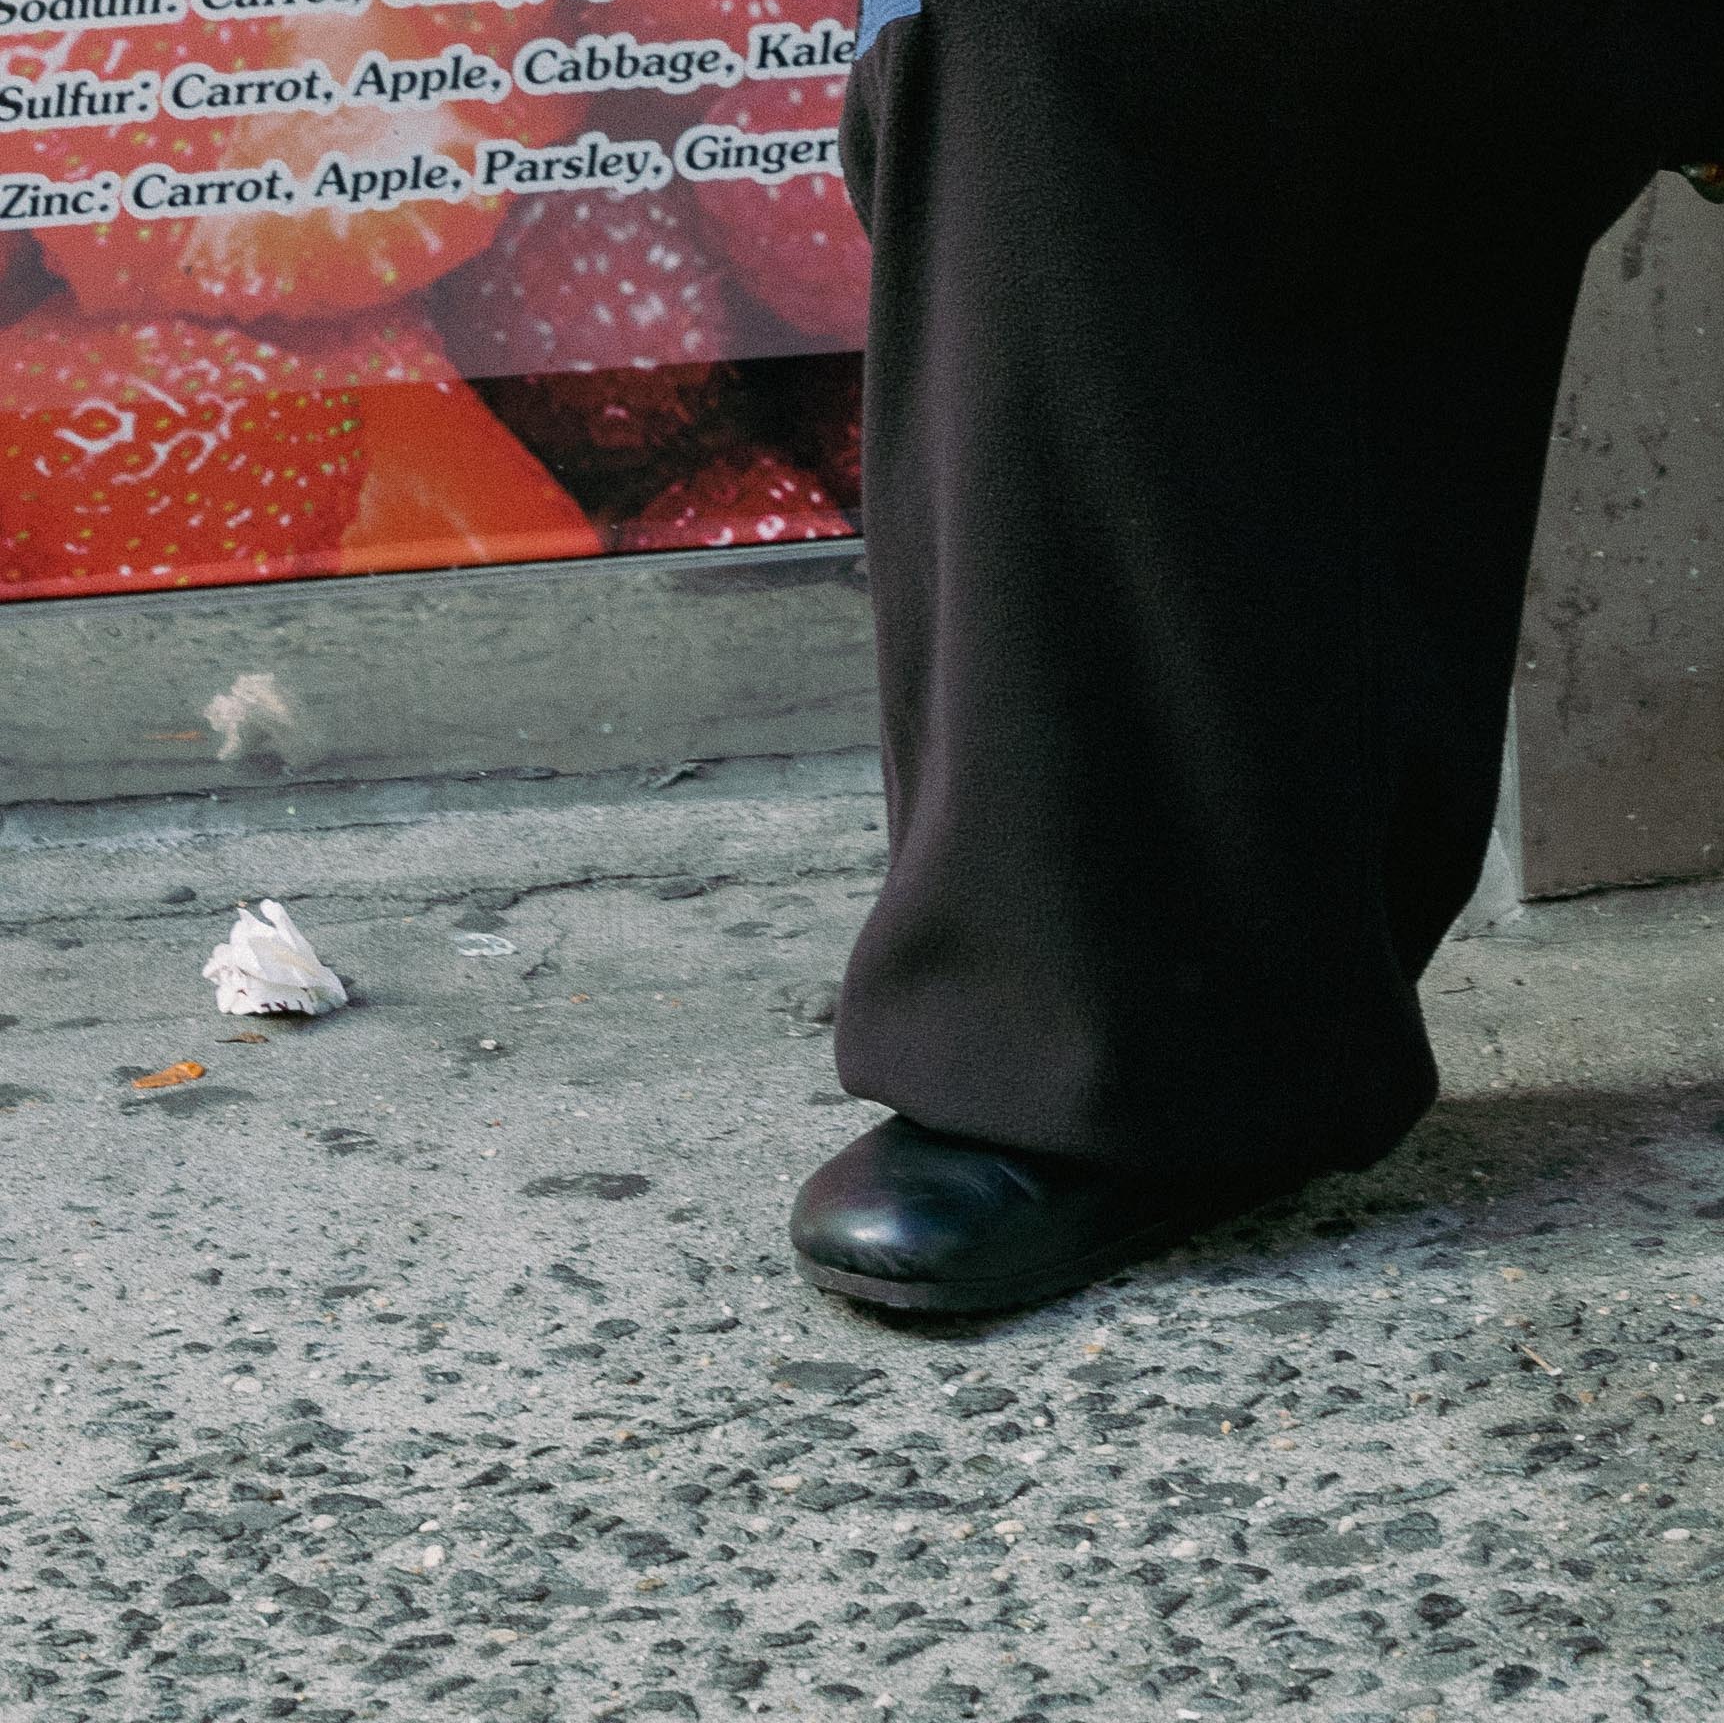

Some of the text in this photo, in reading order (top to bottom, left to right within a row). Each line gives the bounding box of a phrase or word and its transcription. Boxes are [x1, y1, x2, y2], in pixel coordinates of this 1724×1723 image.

[171, 70, 334, 110] Carrot,
[353, 54, 501, 103] Apple,
[523, 41, 735, 85] Cabbage,
[756, 29, 855, 70] Kale
[0, 134, 838, 220] Zinc: Carrot, Apple, Parsley, Ginger
